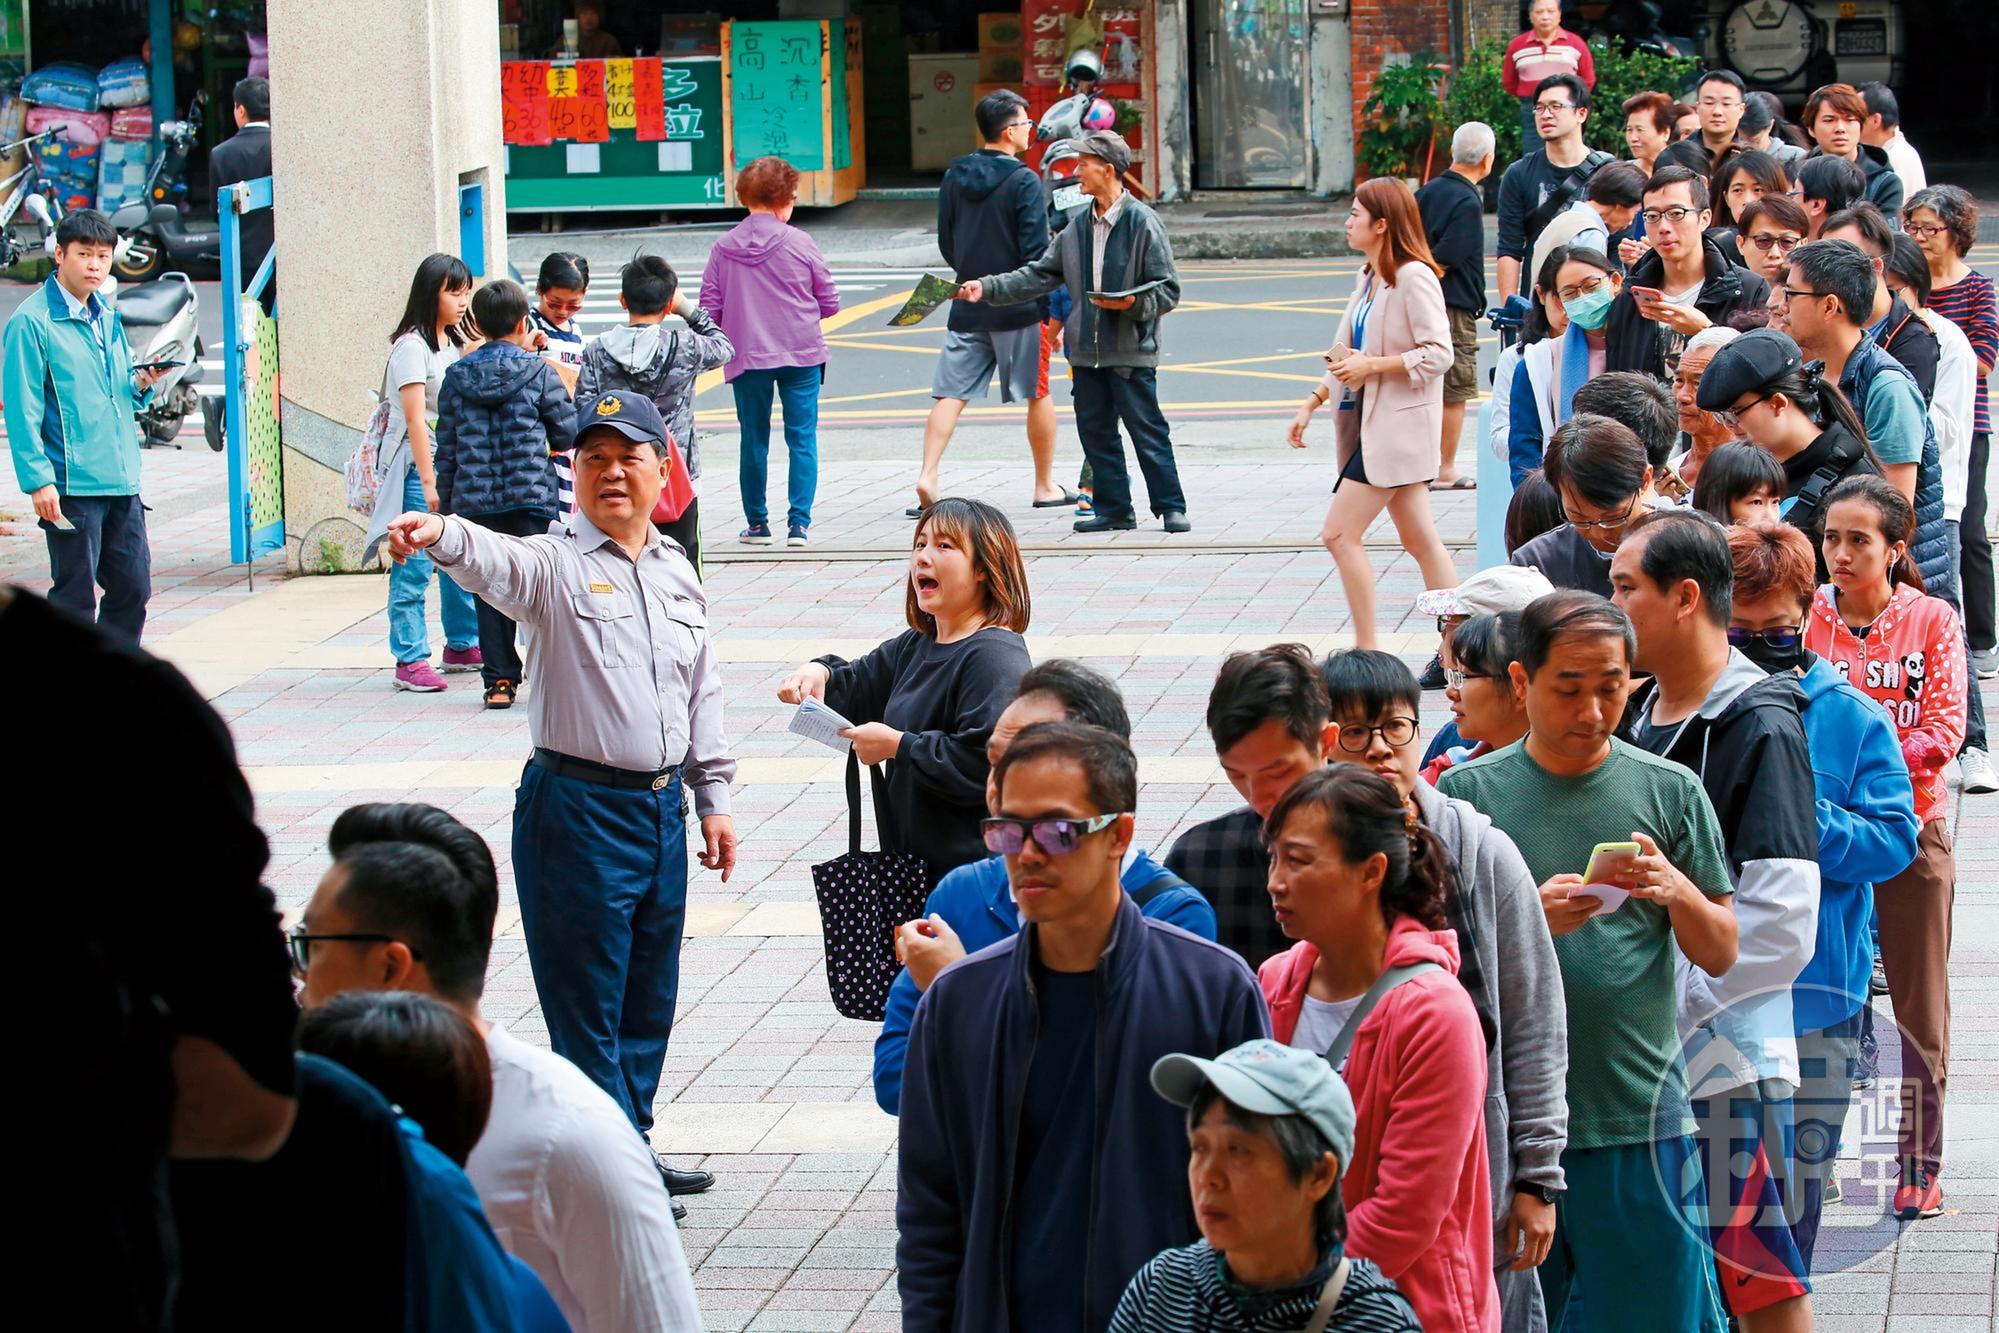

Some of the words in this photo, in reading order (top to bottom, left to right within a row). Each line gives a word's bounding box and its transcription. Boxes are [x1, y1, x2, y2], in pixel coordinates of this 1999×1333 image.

[738, 27, 765, 101] 高山
[501, 107, 517, 134] 6
[550, 98, 575, 128] 46
[610, 101, 635, 118] 100
[1866, 660, 1900, 689] SH
